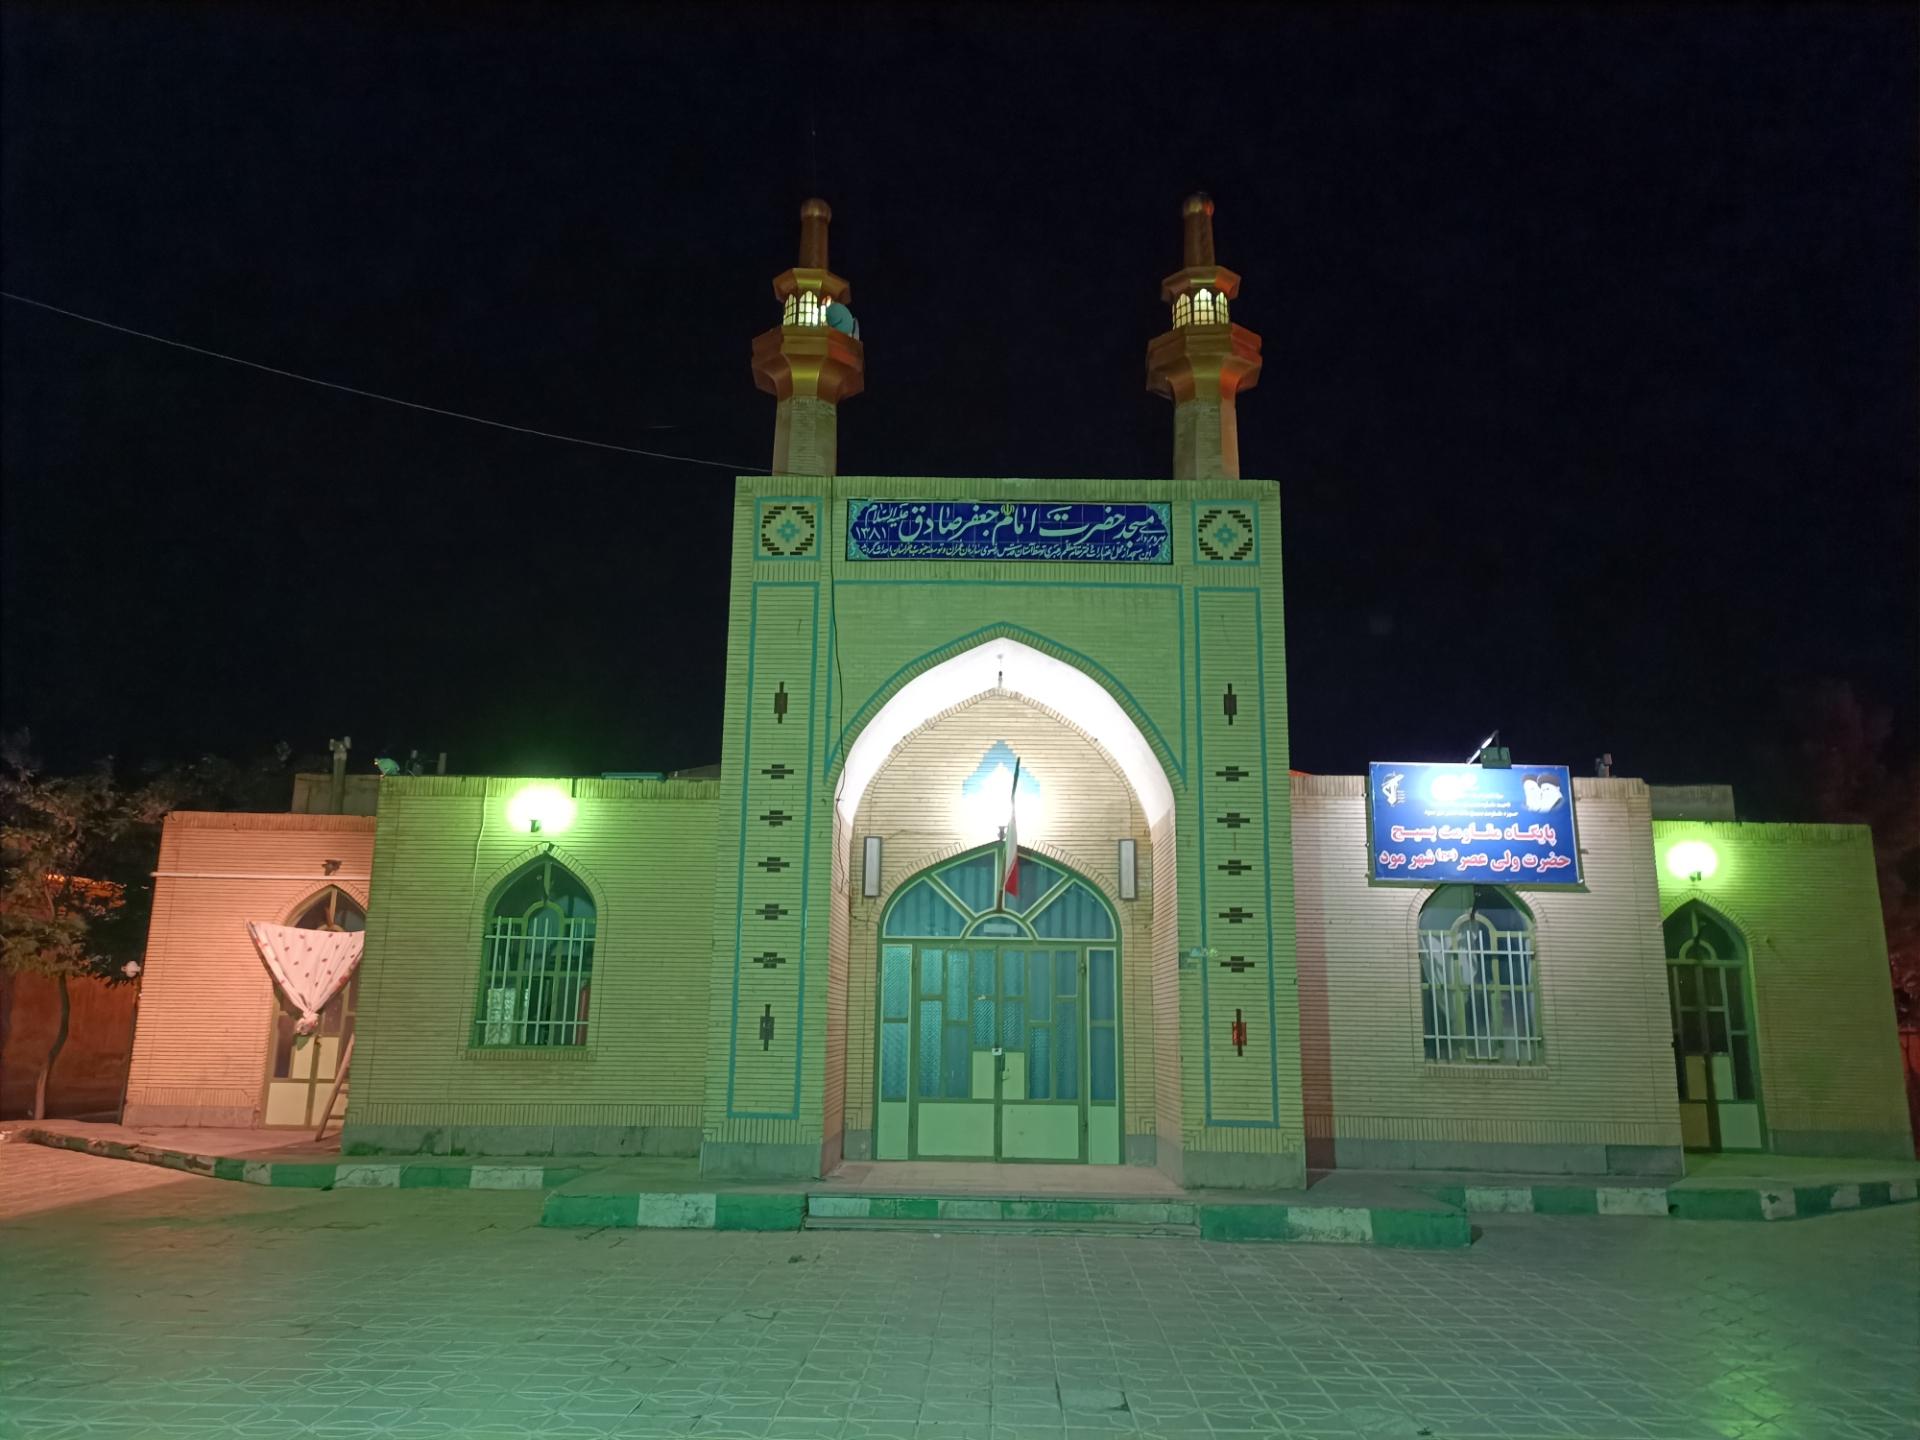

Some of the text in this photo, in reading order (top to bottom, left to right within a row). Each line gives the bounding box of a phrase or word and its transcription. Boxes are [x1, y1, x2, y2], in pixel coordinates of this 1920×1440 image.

[855, 526, 887, 540] ۱۳۸۱
[898, 505, 962, 542] صادق
[948, 504, 999, 542] جعفر
[992, 506, 1037, 546] امام
[1039, 505, 1125, 544] حضرت
[1112, 515, 1155, 549] مسجد
[1391, 821, 1558, 846] پایگاه مقاومت بسیج
[1379, 850, 1406, 869] مود
[1408, 848, 1436, 869] شهر
[1457, 852, 1489, 871] عصر
[1490, 848, 1521, 871] ولی
[1522, 850, 1571, 873] حضرت
